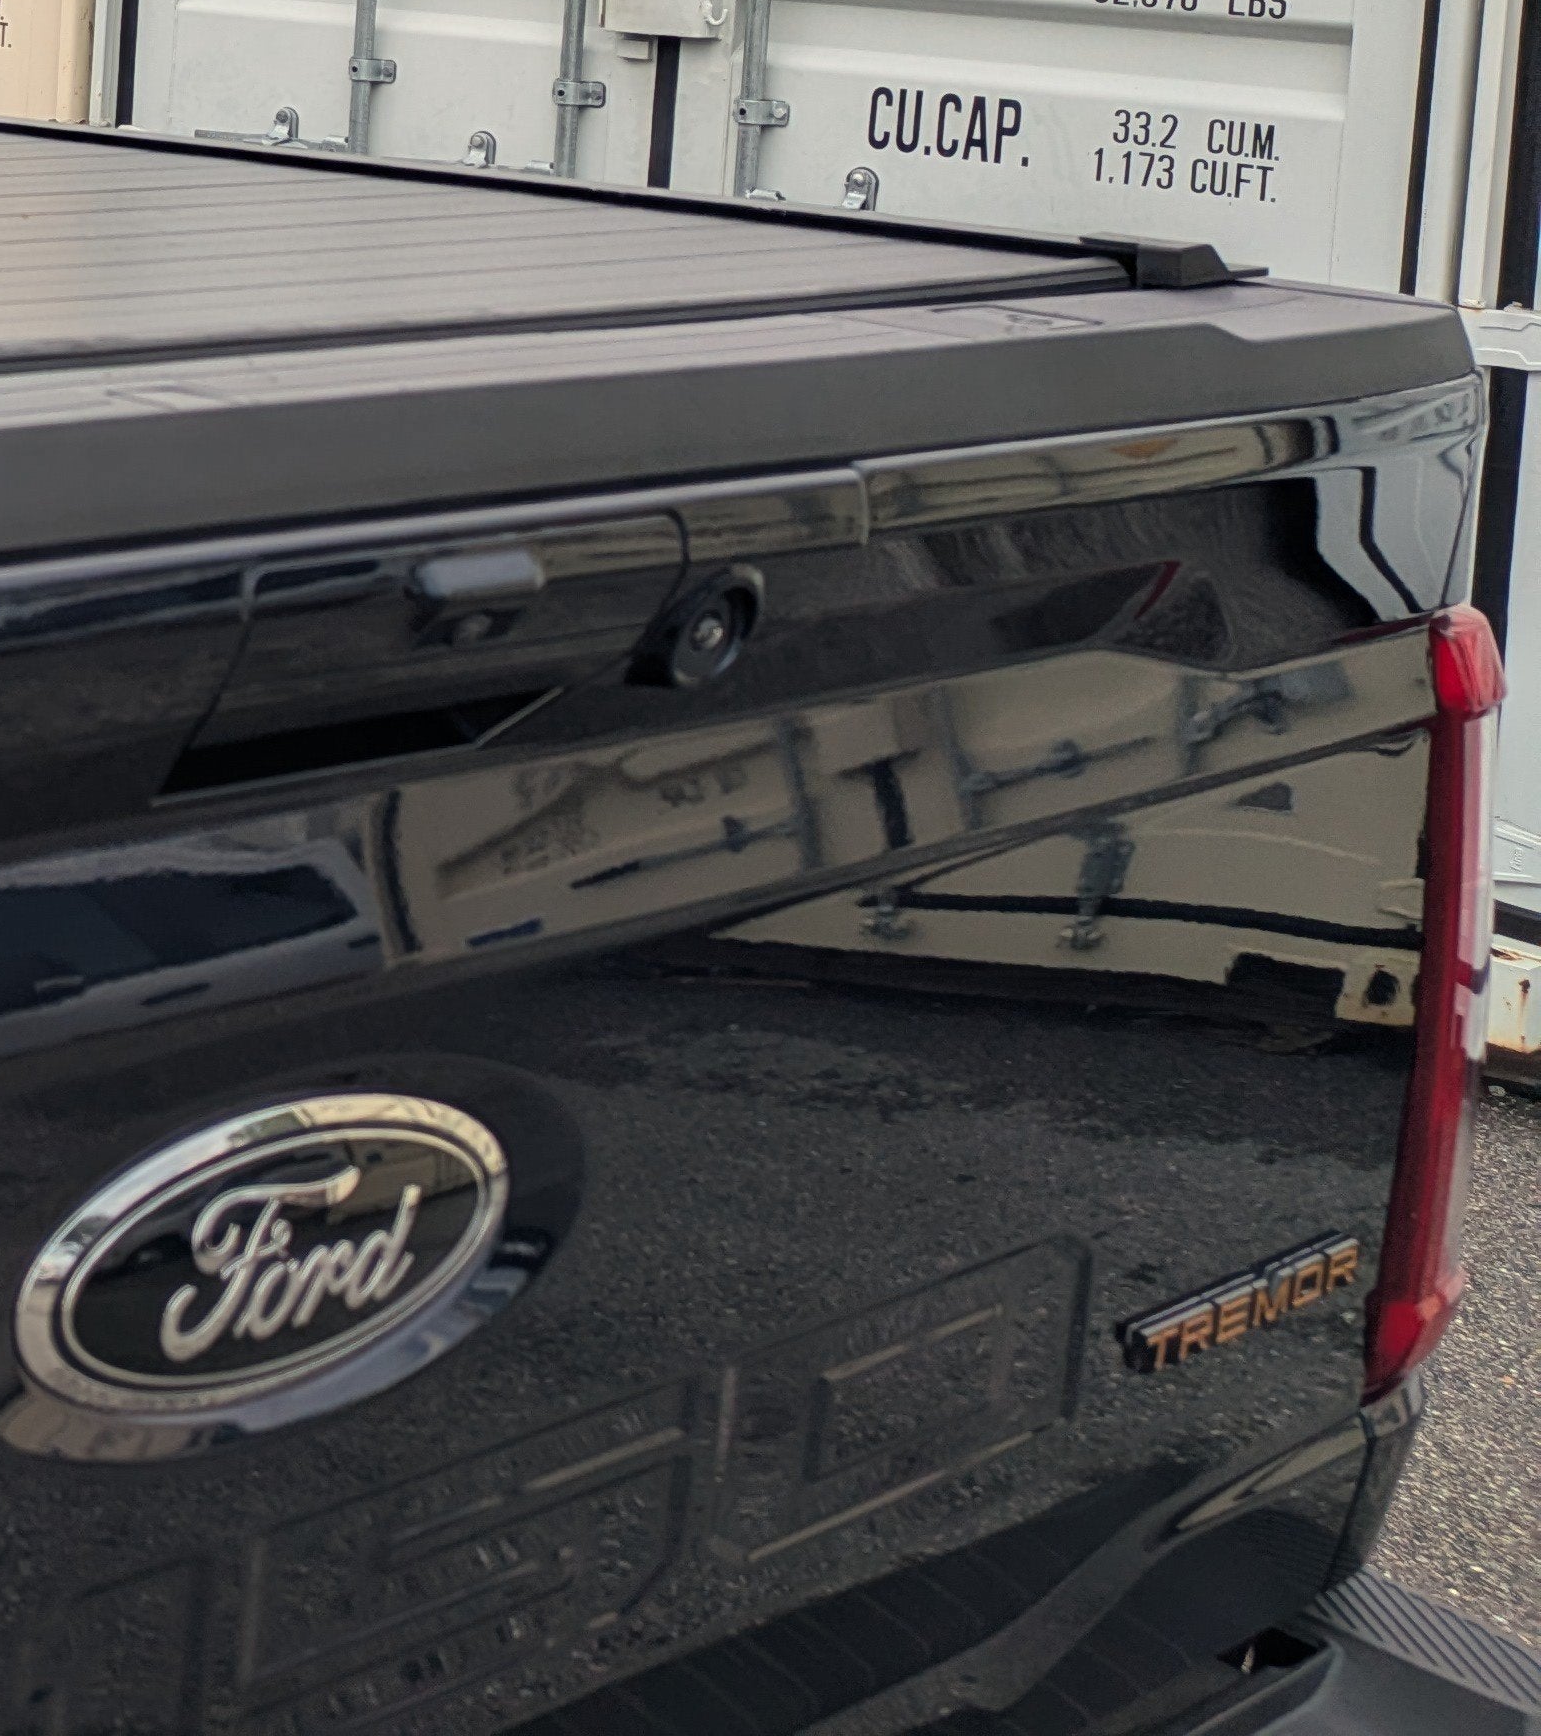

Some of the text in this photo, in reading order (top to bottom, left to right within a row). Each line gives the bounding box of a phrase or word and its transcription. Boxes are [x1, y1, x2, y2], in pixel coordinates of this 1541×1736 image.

[1094, 147, 1280, 203] 1,173 CU.FT.
[1112, 109, 1280, 162] 33.2 CU.M.
[160, 1164, 423, 1363] Ford
[1143, 1236, 1361, 1371] TREMOR
